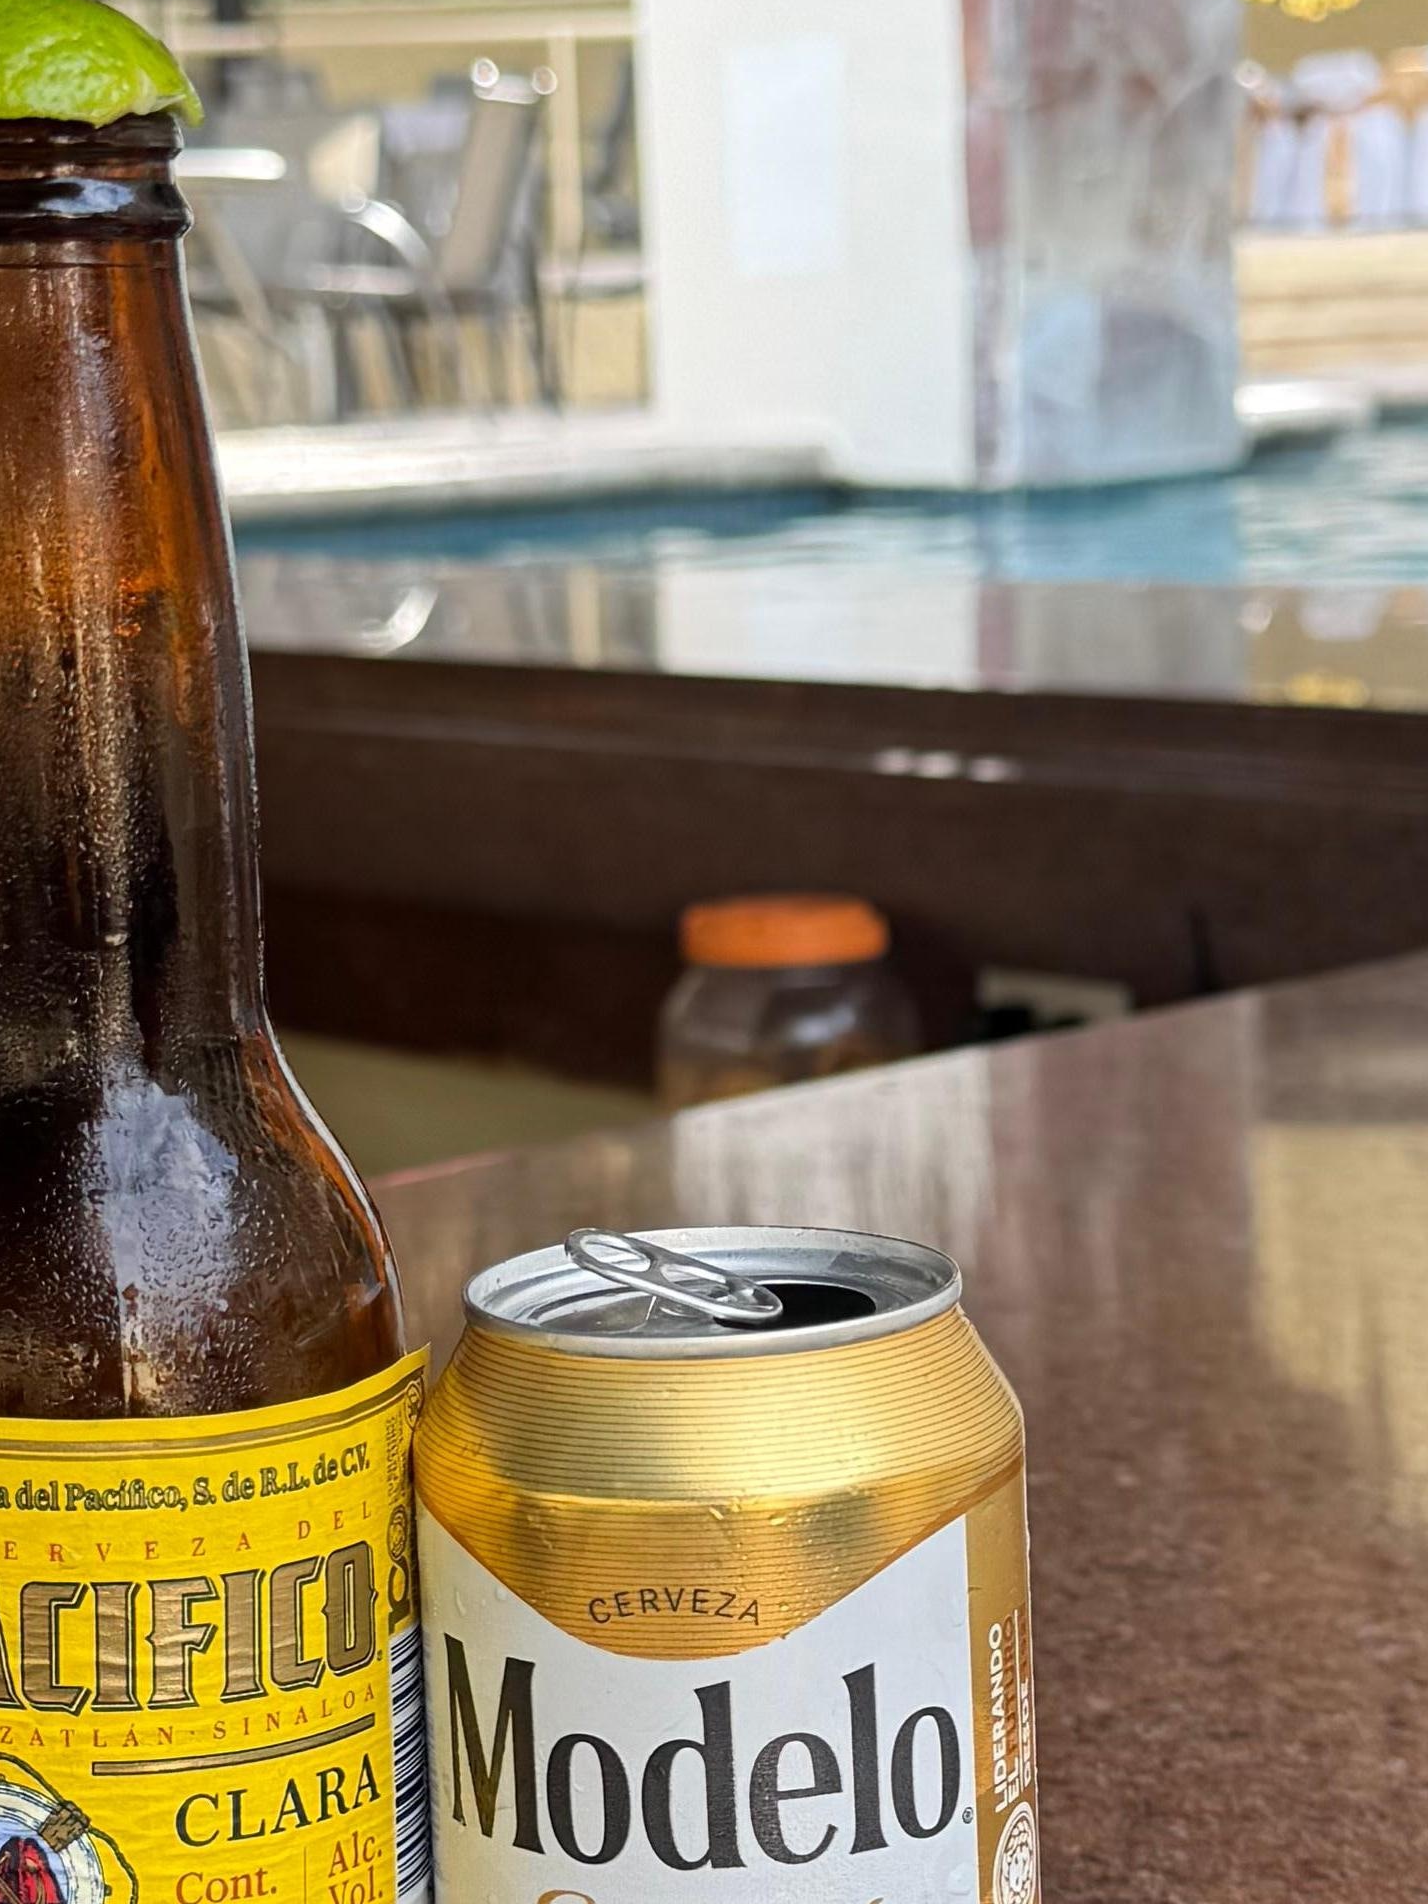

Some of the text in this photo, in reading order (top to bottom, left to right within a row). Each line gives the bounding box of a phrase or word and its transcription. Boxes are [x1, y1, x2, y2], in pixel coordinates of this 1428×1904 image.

[15, 1479, 60, 1512] del
[192, 1476, 216, 1506] S.
[222, 1470, 255, 1503] de
[260, 1462, 310, 1497] R.L.
[313, 1452, 339, 1485] de
[297, 1500, 372, 1540] DEL
[588, 1586, 761, 1627] CERVEZA
[212, 1686, 376, 1741] SINALOA
[987, 1622, 1008, 1813] LIDERANDO
[1020, 1676, 1032, 1788] DESDE
[443, 1632, 962, 1872] Modelo
[1006, 1756, 1021, 1804] EL
[176, 1753, 382, 1847] CLARA
[328, 1831, 383, 1879] Alc.
